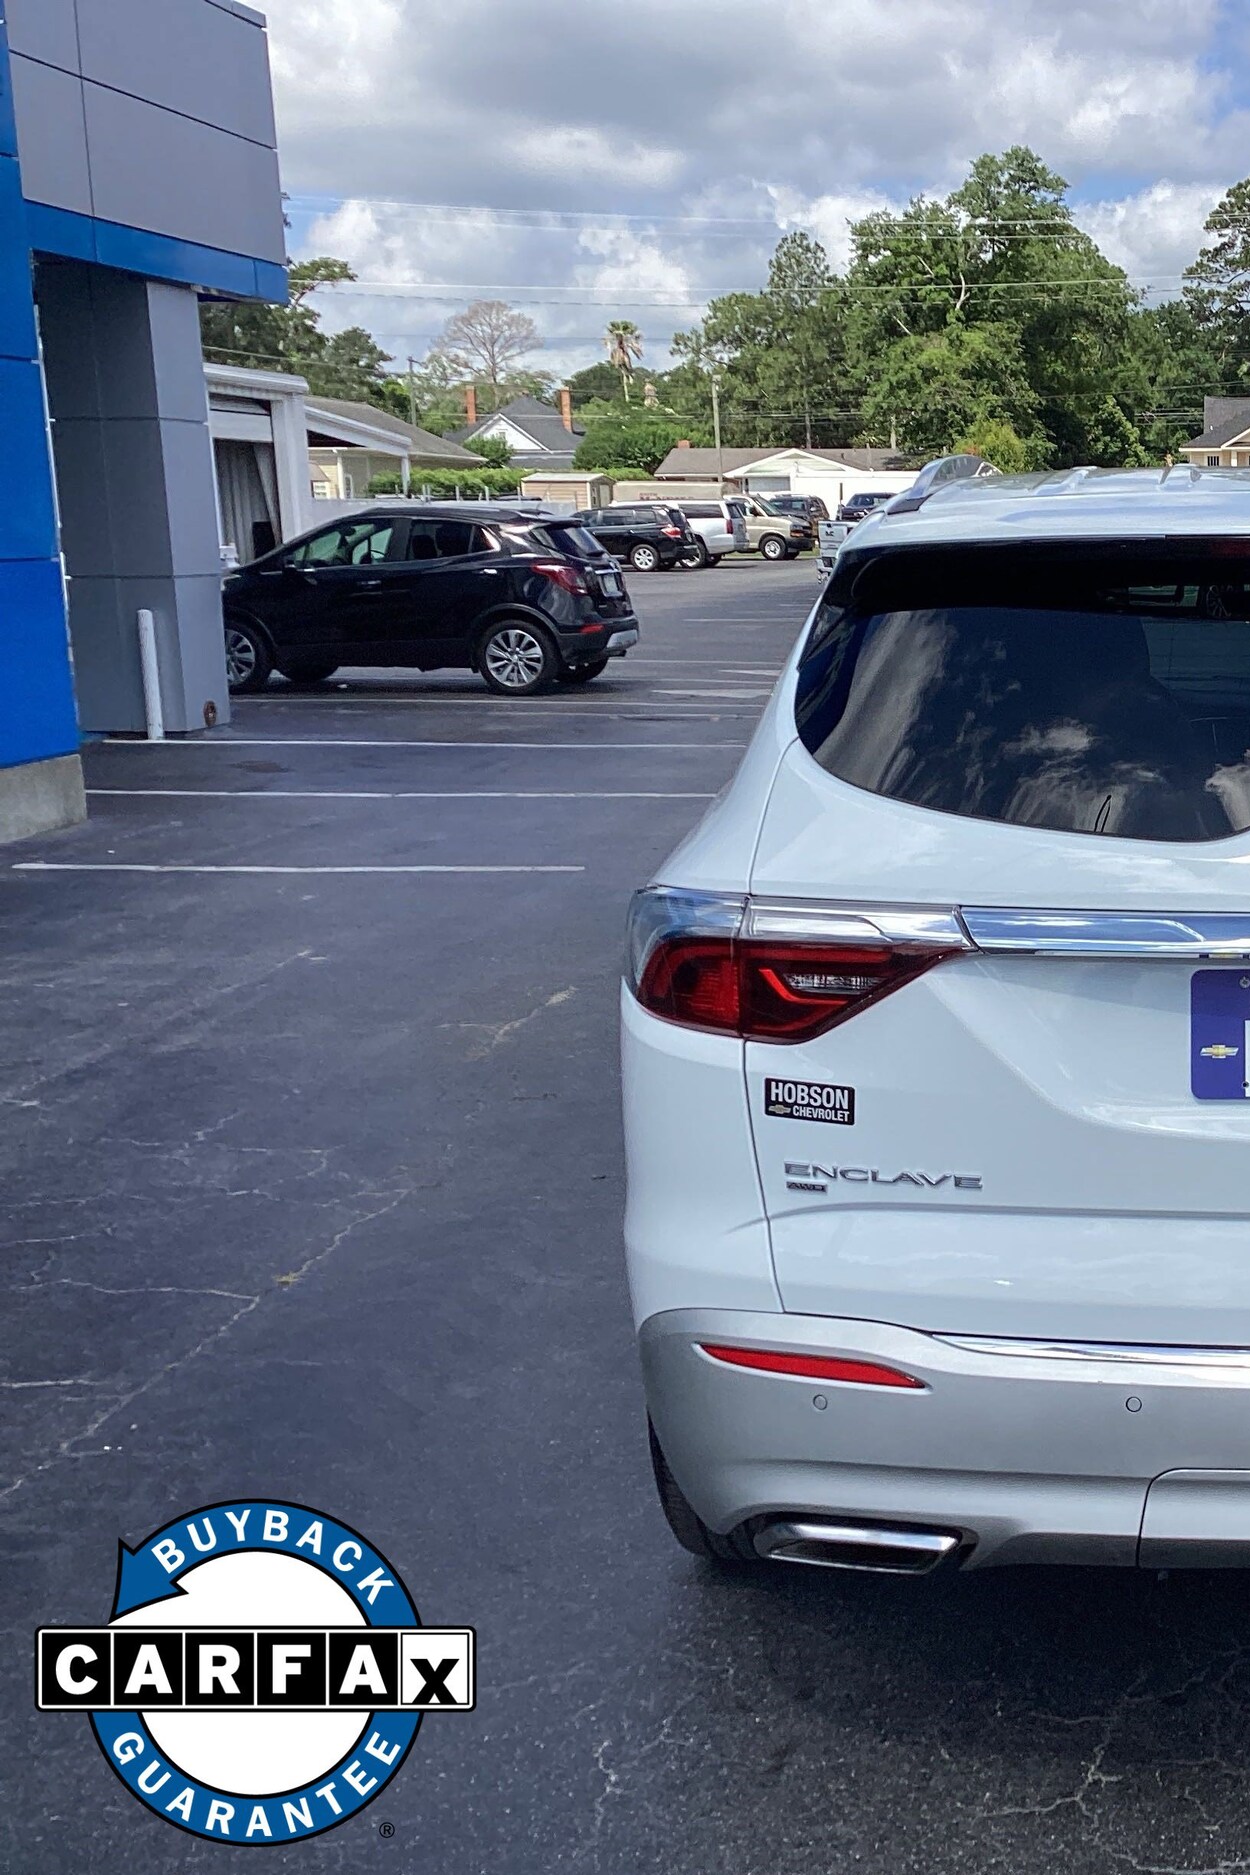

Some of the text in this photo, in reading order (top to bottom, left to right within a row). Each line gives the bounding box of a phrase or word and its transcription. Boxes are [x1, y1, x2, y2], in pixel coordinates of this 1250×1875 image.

[770, 1081, 849, 1110] HOBSON
[792, 1105, 850, 1122] CHEVROLET
[783, 1161, 983, 1190] ENCLAVE
